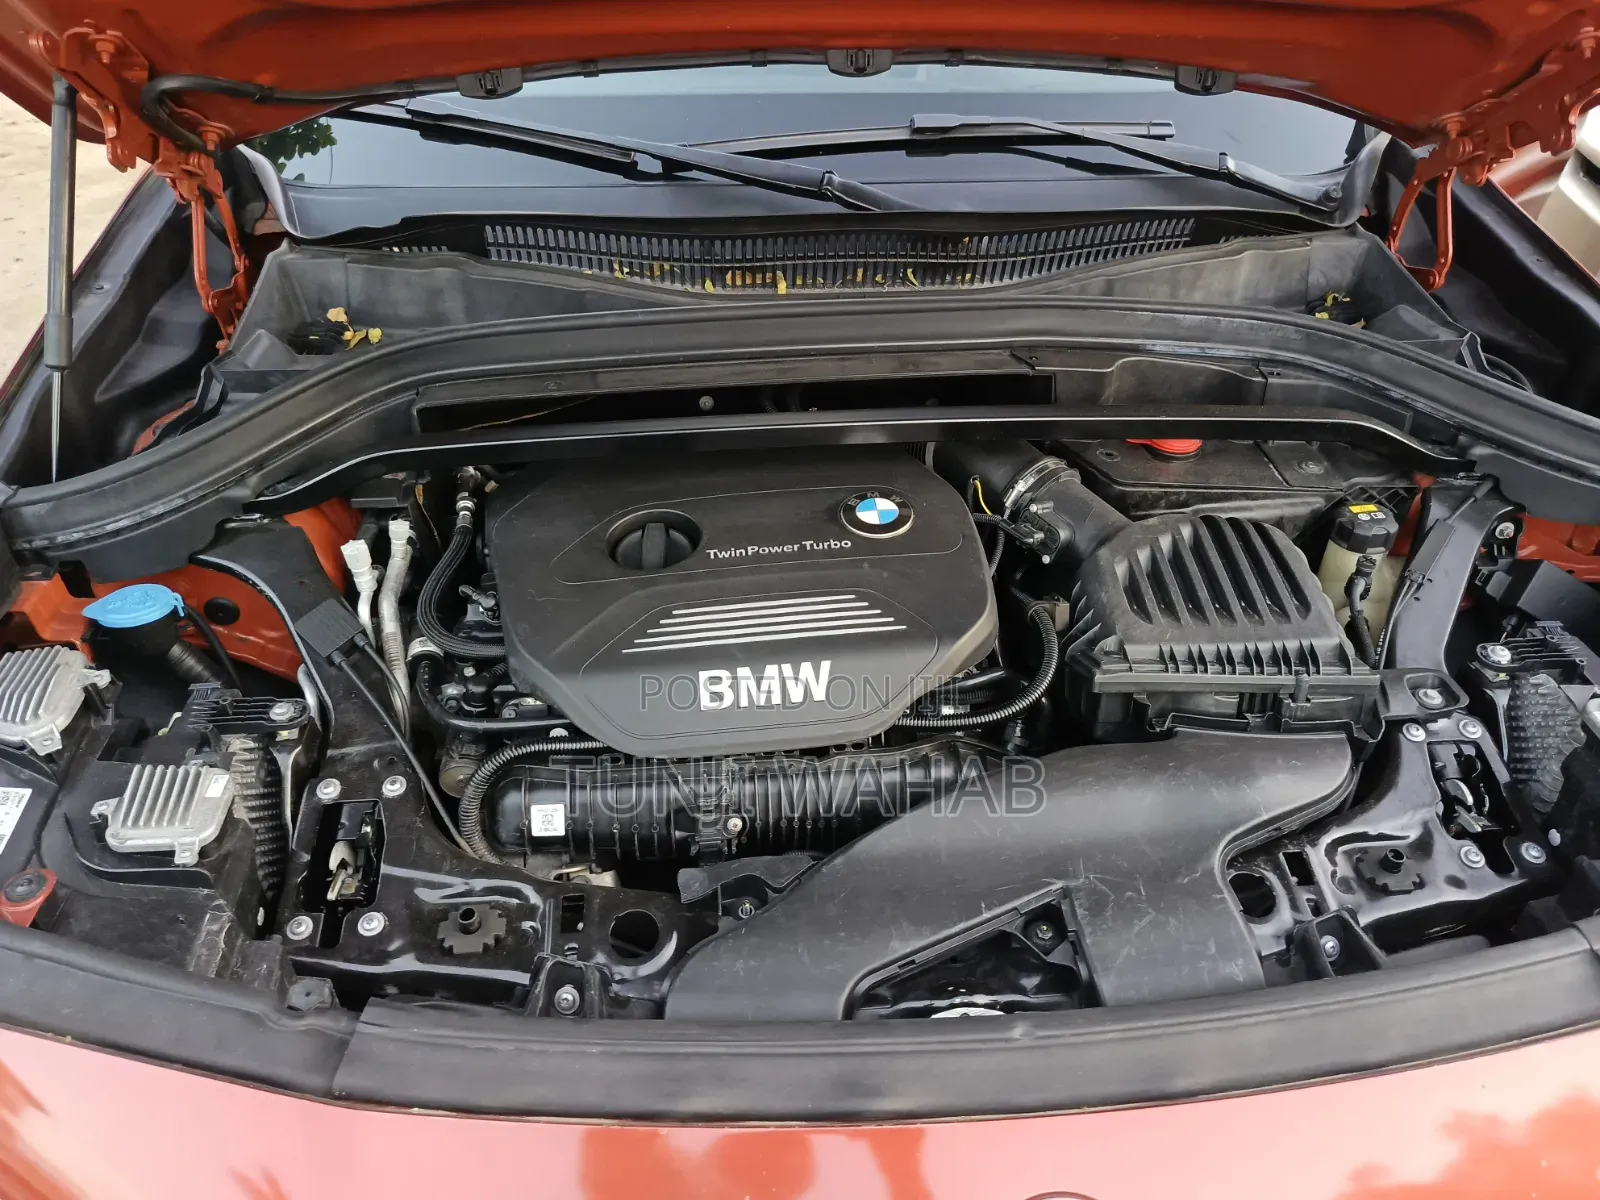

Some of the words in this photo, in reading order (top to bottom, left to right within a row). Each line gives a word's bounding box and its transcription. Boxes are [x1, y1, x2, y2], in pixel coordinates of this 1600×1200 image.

[847, 491, 904, 507] BMW
[705, 543, 801, 560] TwinPower
[801, 539, 852, 551] Turbo
[698, 660, 831, 711] BMW
